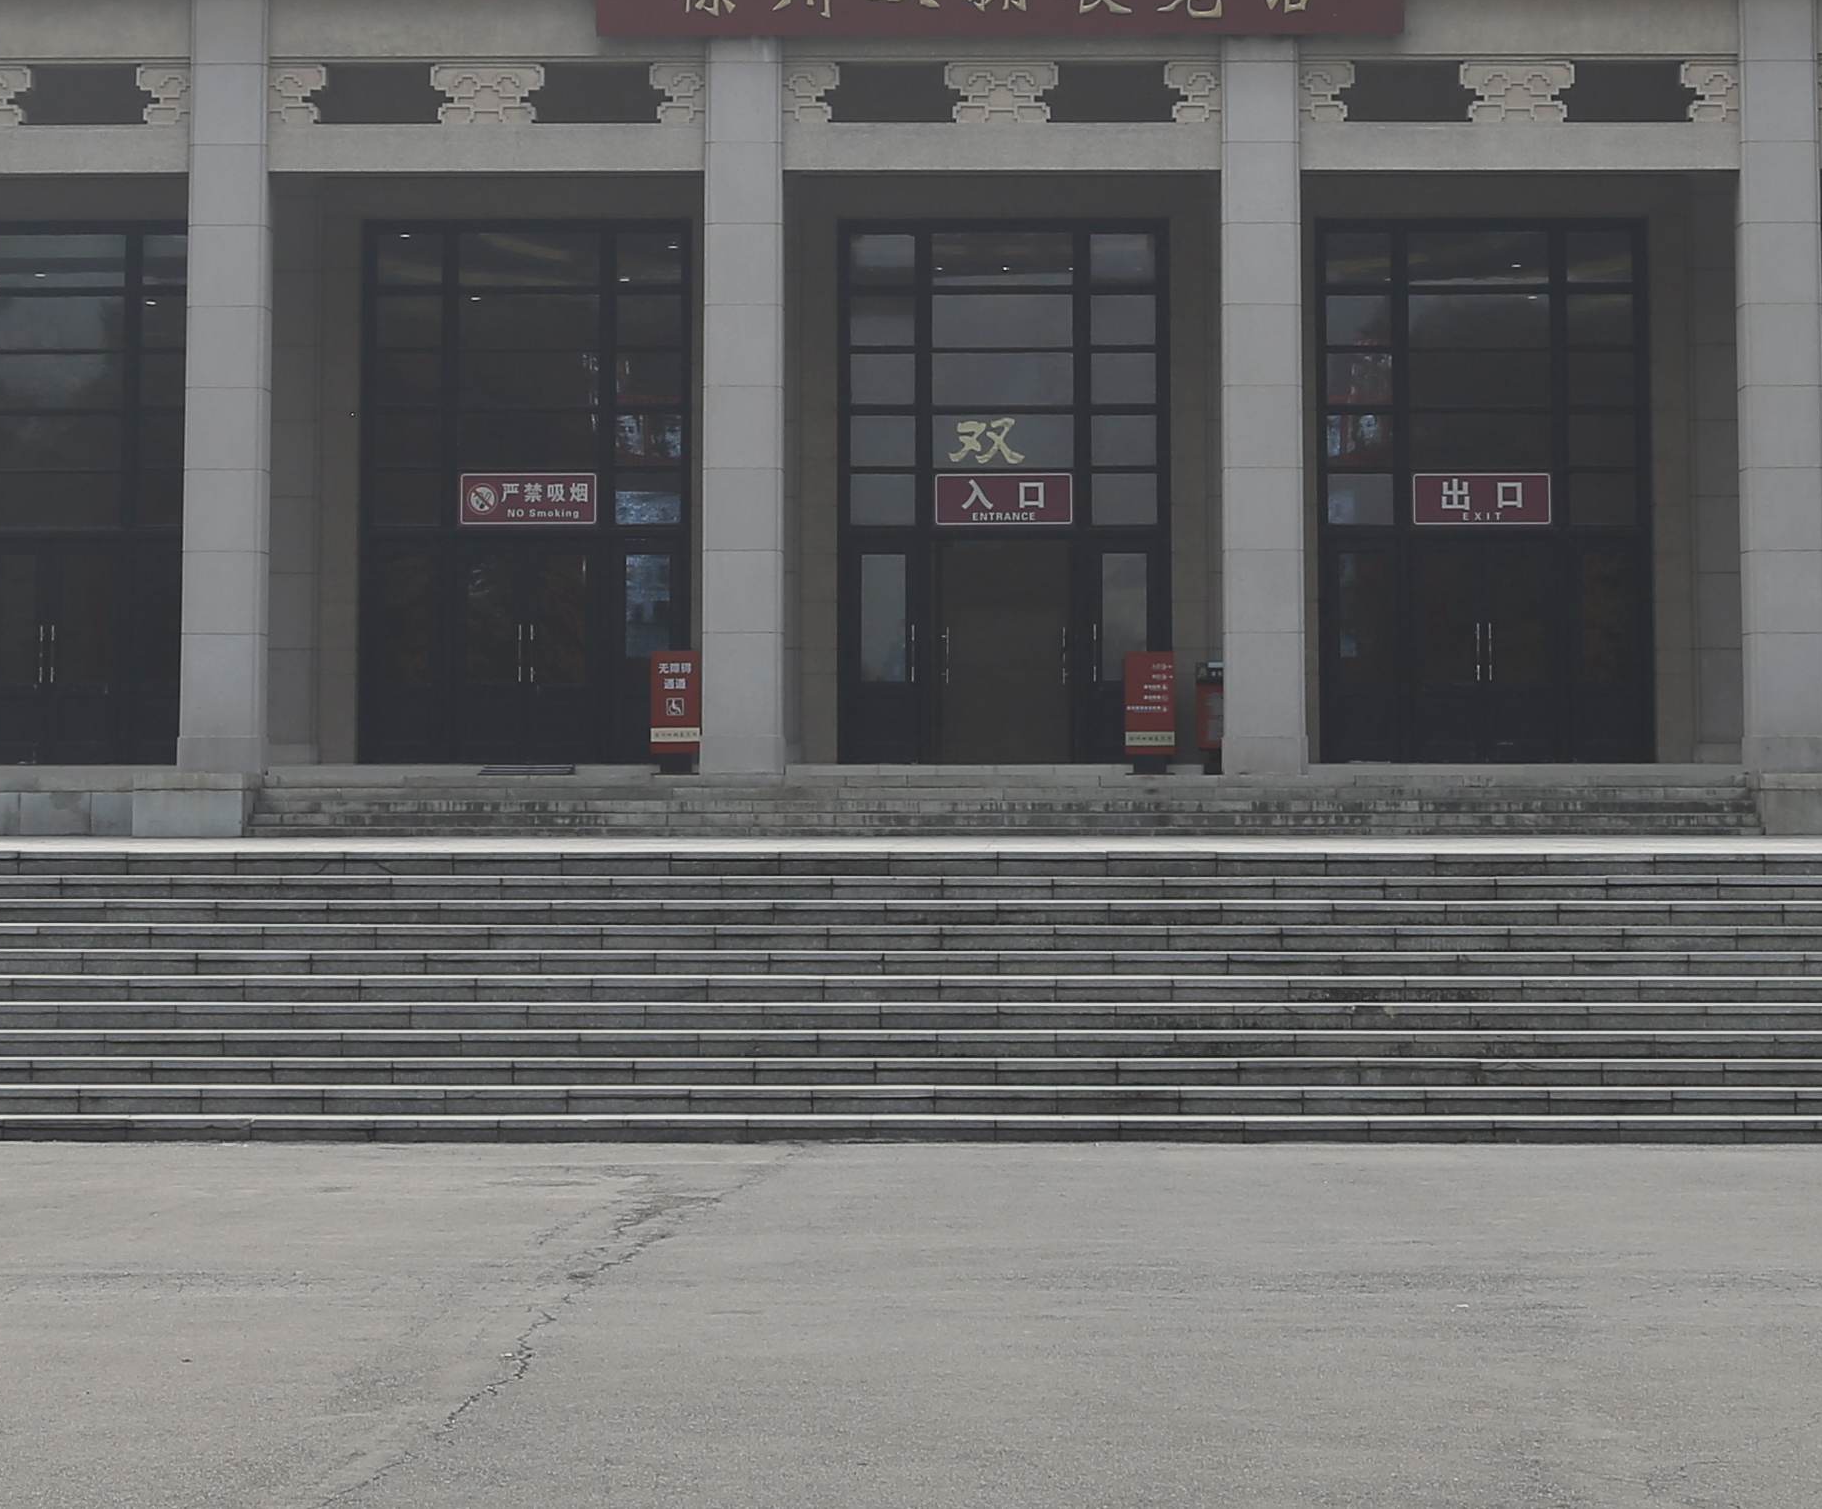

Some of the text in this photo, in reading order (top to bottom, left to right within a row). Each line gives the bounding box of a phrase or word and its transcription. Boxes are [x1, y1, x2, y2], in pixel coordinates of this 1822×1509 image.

[947, 417, 1026, 465] 双
[500, 482, 589, 504] 严禁吸烟
[961, 478, 1045, 510] 入口
[1441, 477, 1523, 511] 出口
[506, 508, 580, 519] NO Smoking
[971, 511, 1037, 522] ENTRANCE
[1462, 511, 1503, 521] EXIT
